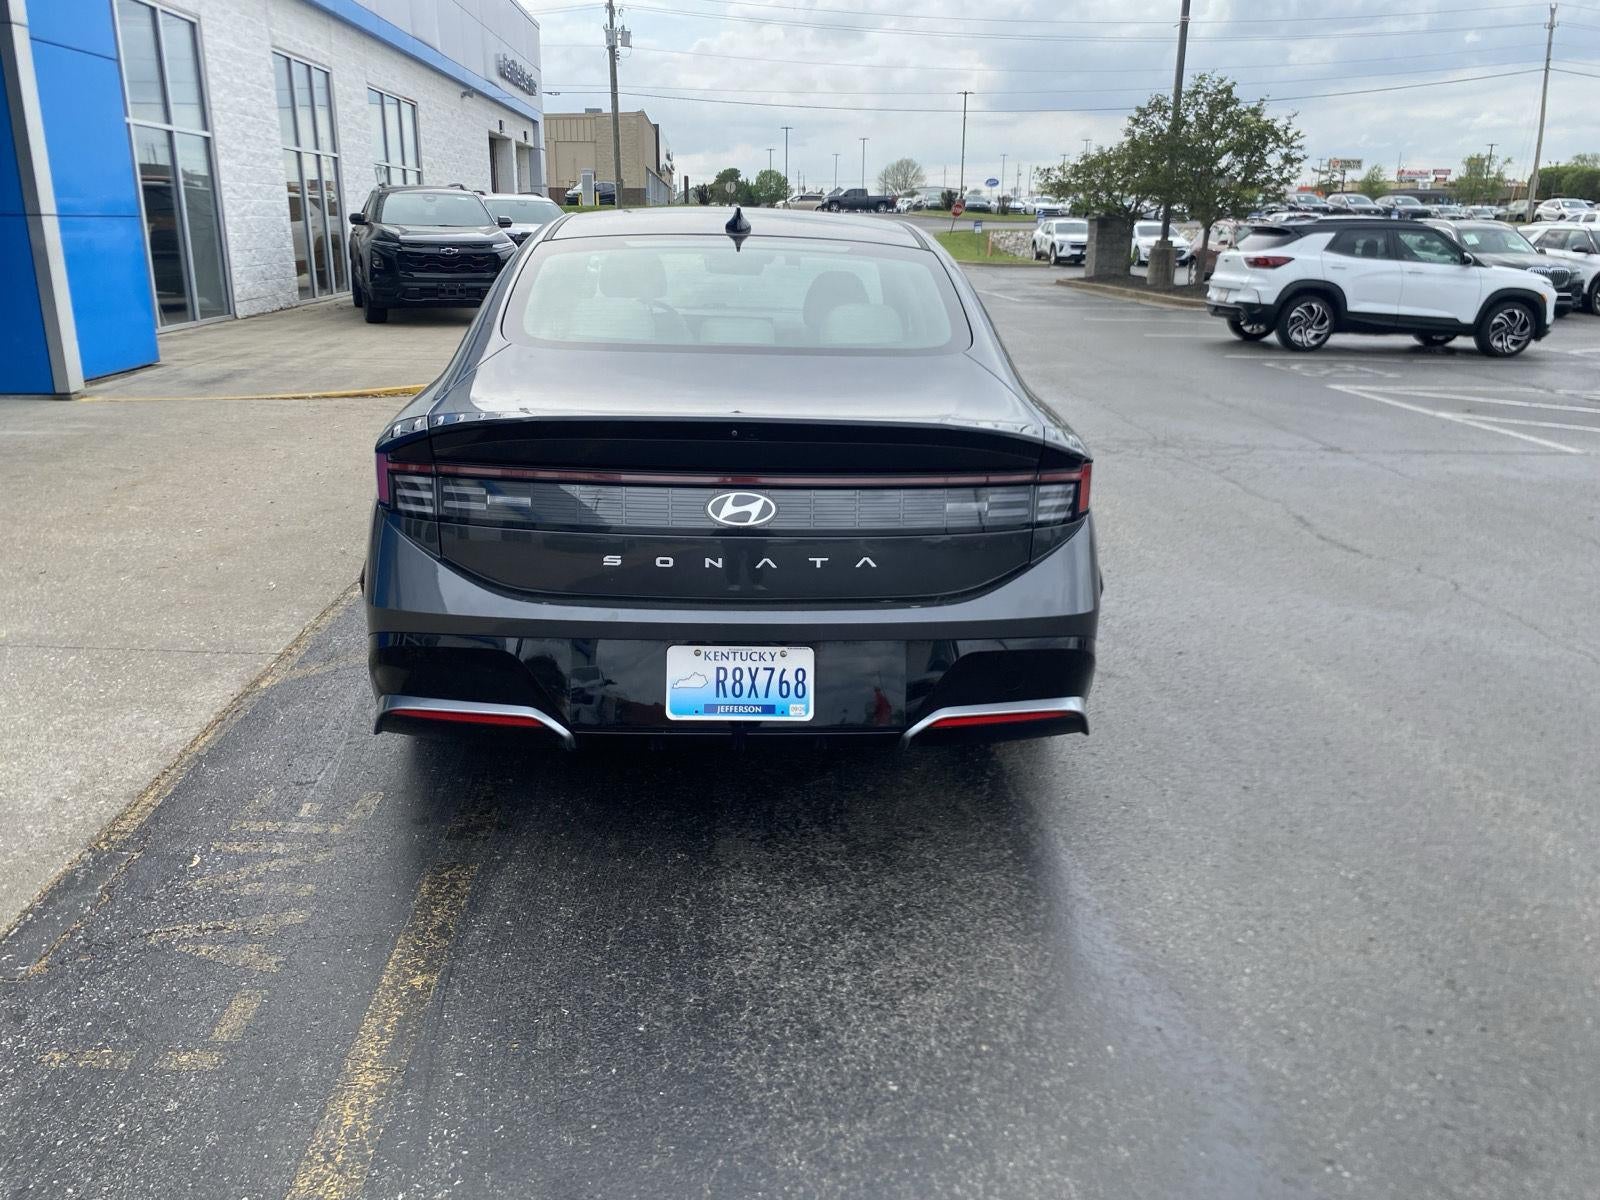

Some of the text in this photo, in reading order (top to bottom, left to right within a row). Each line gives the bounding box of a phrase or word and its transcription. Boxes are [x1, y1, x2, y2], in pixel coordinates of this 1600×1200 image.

[603, 555, 877, 569] SONATA
[704, 651, 777, 662] KENTUCKY
[715, 666, 807, 699] R8X768
[717, 705, 762, 713] JEFFERSON
